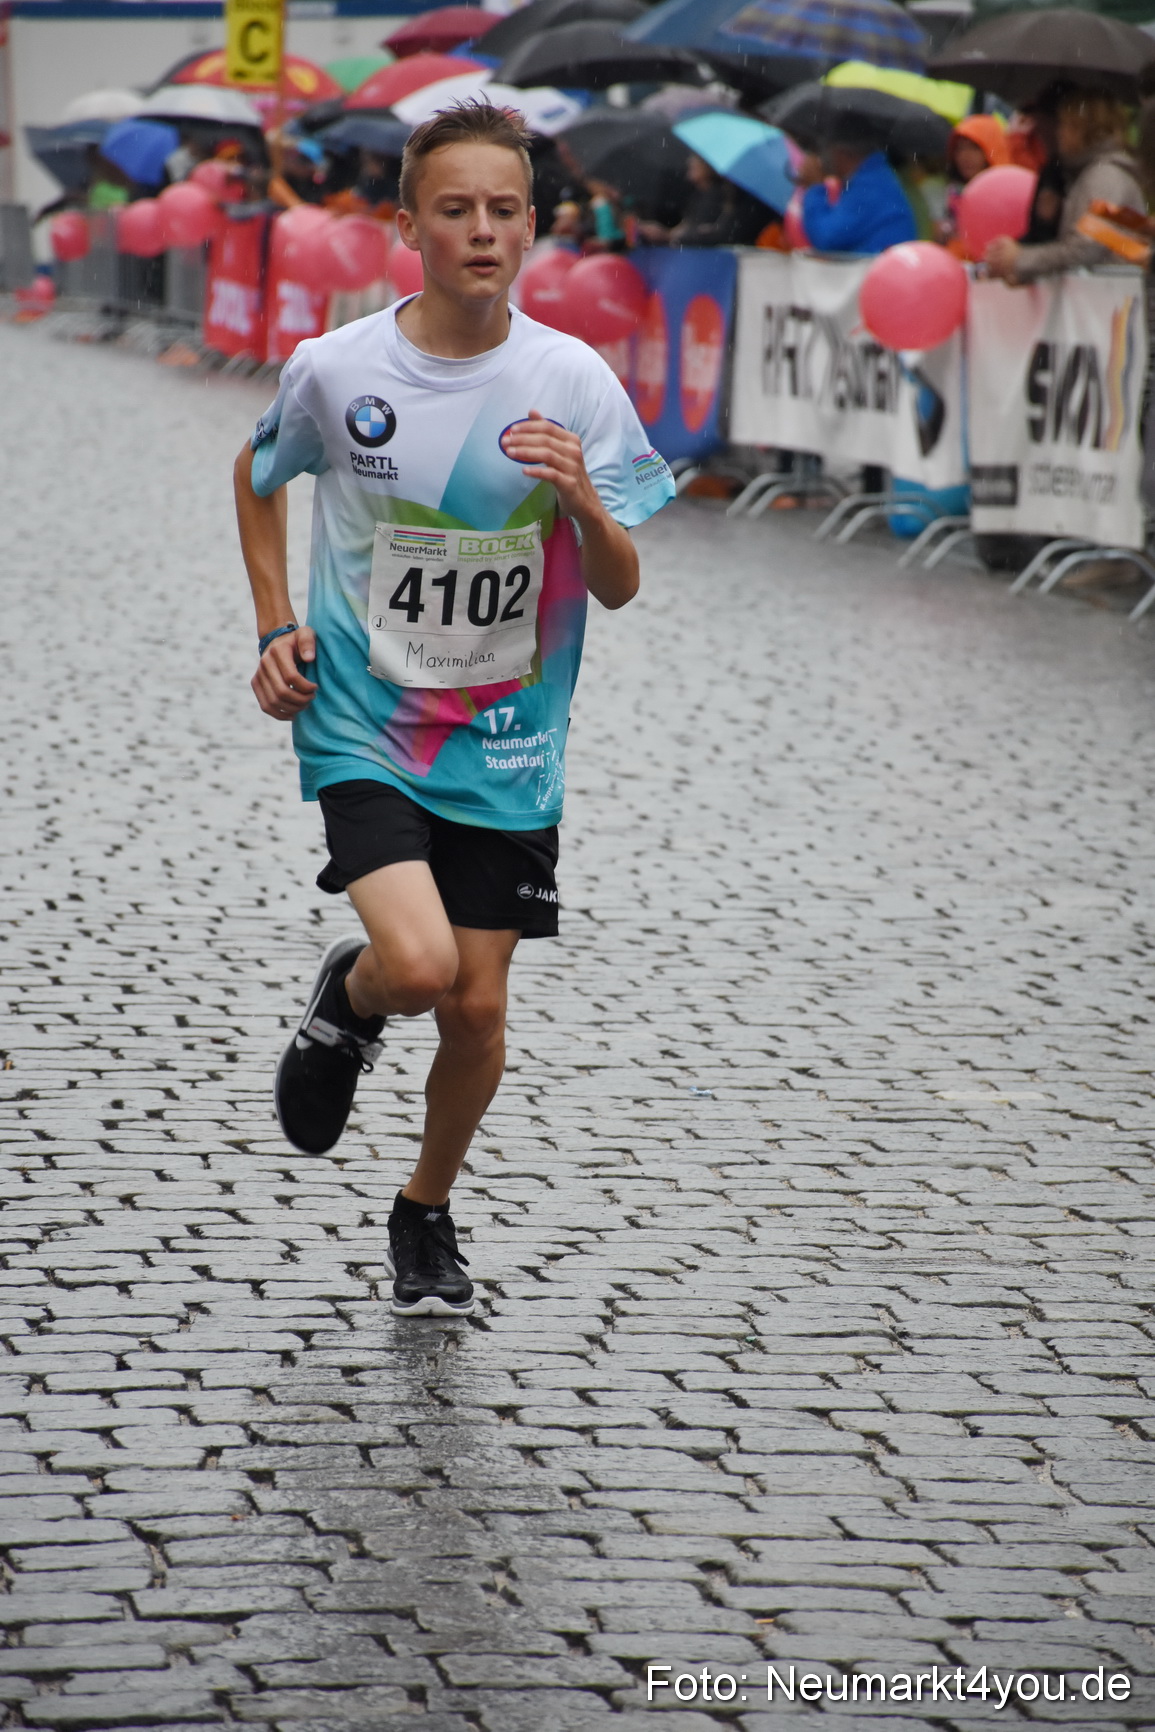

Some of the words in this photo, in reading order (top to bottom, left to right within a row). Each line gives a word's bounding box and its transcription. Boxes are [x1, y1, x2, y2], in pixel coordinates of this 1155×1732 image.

[239, 20, 270, 64] C
[350, 397, 392, 415] BMW
[350, 451, 399, 471] PARTL
[352, 464, 399, 481] Neumarkt
[390, 542, 448, 557] NeuerMarkt
[458, 531, 535, 556] BOCK
[389, 565, 531, 627] 4102
[376, 617, 382, 628] J
[406, 641, 496, 670] Maximilian
[483, 706, 521, 735] 17.
[535, 888, 560, 903] JAK
